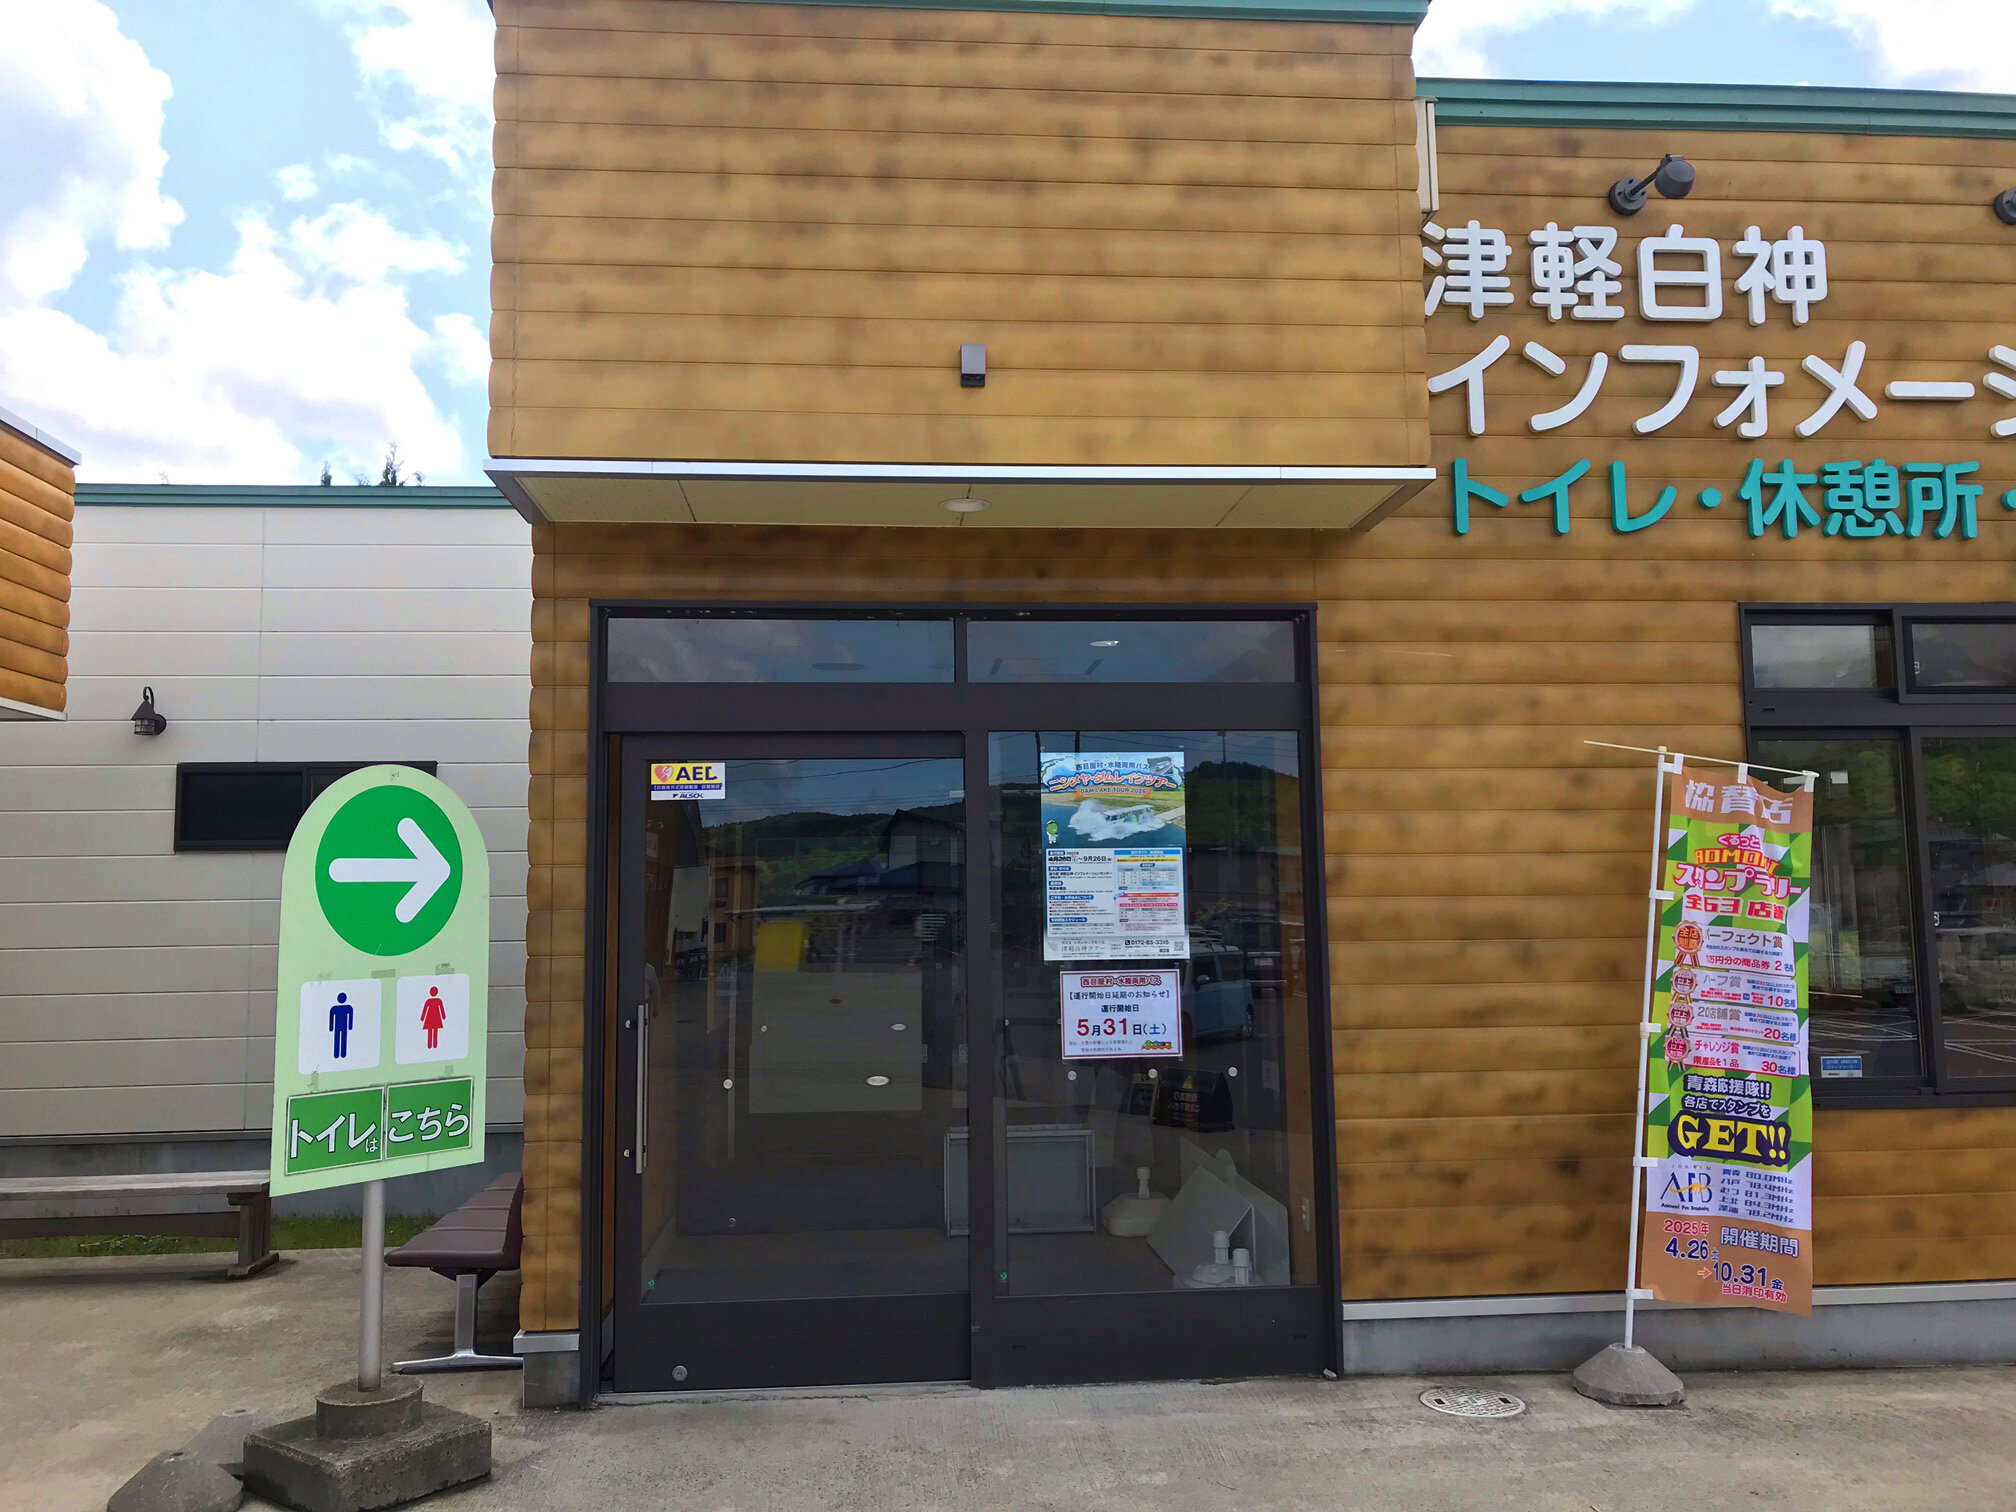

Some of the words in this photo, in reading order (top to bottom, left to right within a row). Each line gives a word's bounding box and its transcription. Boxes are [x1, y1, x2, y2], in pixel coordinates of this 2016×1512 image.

[1422, 219, 1828, 327] 津軽白神
[1685, 779, 1794, 825] 協賛店
[1717, 833, 1761, 848] ぐるっと
[1672, 862, 1802, 899] スタンプラリー
[1069, 990, 1170, 1000] 【運行開始日延期のお知らせ】
[1100, 1004, 1140, 1013] 運行開始日
[1763, 1027, 1797, 1041] 20名様
[1694, 1039, 1740, 1055] チャレンジ賞
[1761, 1060, 1797, 1075] 30名様
[1684, 1095, 1771, 1117] 各店でスタンプを
[387, 1102, 470, 1143] こちら
[1677, 1114, 1786, 1160] GET!!
[1663, 1219, 1709, 1236] 2025年
[1720, 1226, 1799, 1258] 開催期間
[1721, 1283, 1788, 1303] 当日消印有効
